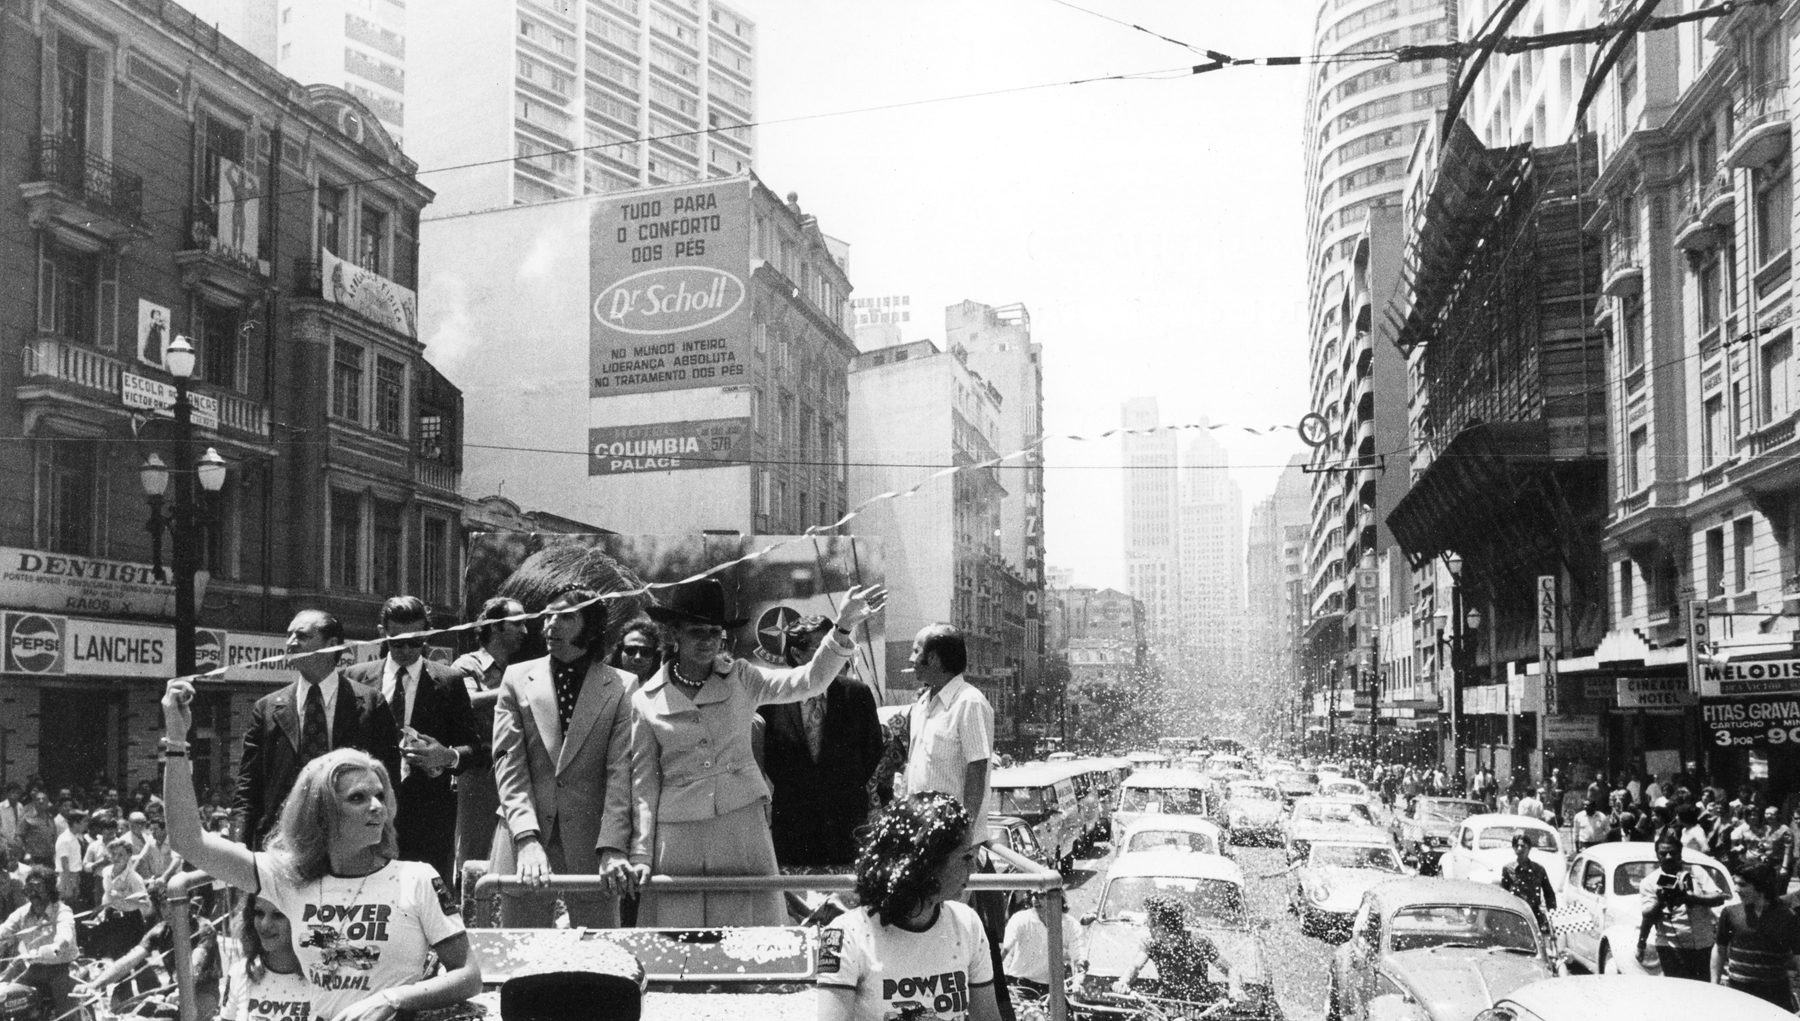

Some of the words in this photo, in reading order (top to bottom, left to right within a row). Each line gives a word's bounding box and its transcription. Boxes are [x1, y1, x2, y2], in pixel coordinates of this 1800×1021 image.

[621, 201, 661, 220] TUDO
[674, 193, 717, 214] PARA
[617, 227, 627, 243] O
[639, 214, 720, 240] CONFORTO
[632, 245, 662, 263] DOS
[675, 238, 705, 258] PÉS
[609, 288, 642, 324] Dr
[641, 277, 727, 316] Scholl
[612, 349, 626, 360] NO
[634, 343, 675, 357] MUNDO
[683, 338, 726, 352] INTEIRO
[602, 358, 665, 374] LIDERANÇA
[673, 352, 736, 367] ABSOLUTA
[124, 375, 164, 397] ESCOLA
[594, 377, 609, 388] NO
[616, 369, 686, 386] TRATAMENTO
[692, 366, 715, 379] DOS
[721, 364, 744, 375] PÉS
[594, 437, 699, 459] COLUMBIA
[610, 456, 681, 471] PALACE
[66, 596, 109, 612] RAIOS
[1542, 578, 1553, 634] CASA
[11, 636, 60, 652] PEPSI
[74, 634, 164, 664] LANCHES
[196, 648, 220, 661] EPSI
[1639, 692, 1681, 704] HOTEL
[1703, 704, 1745, 722] FITAS
[1710, 721, 1764, 729] CARTUCHO
[1715, 730, 1732, 746] 3
[1733, 736, 1753, 745] POR
[302, 903, 392, 923] POWER
[346, 922, 389, 942] OIL
[883, 970, 967, 1000] POWER
[934, 991, 968, 1013] OIL
